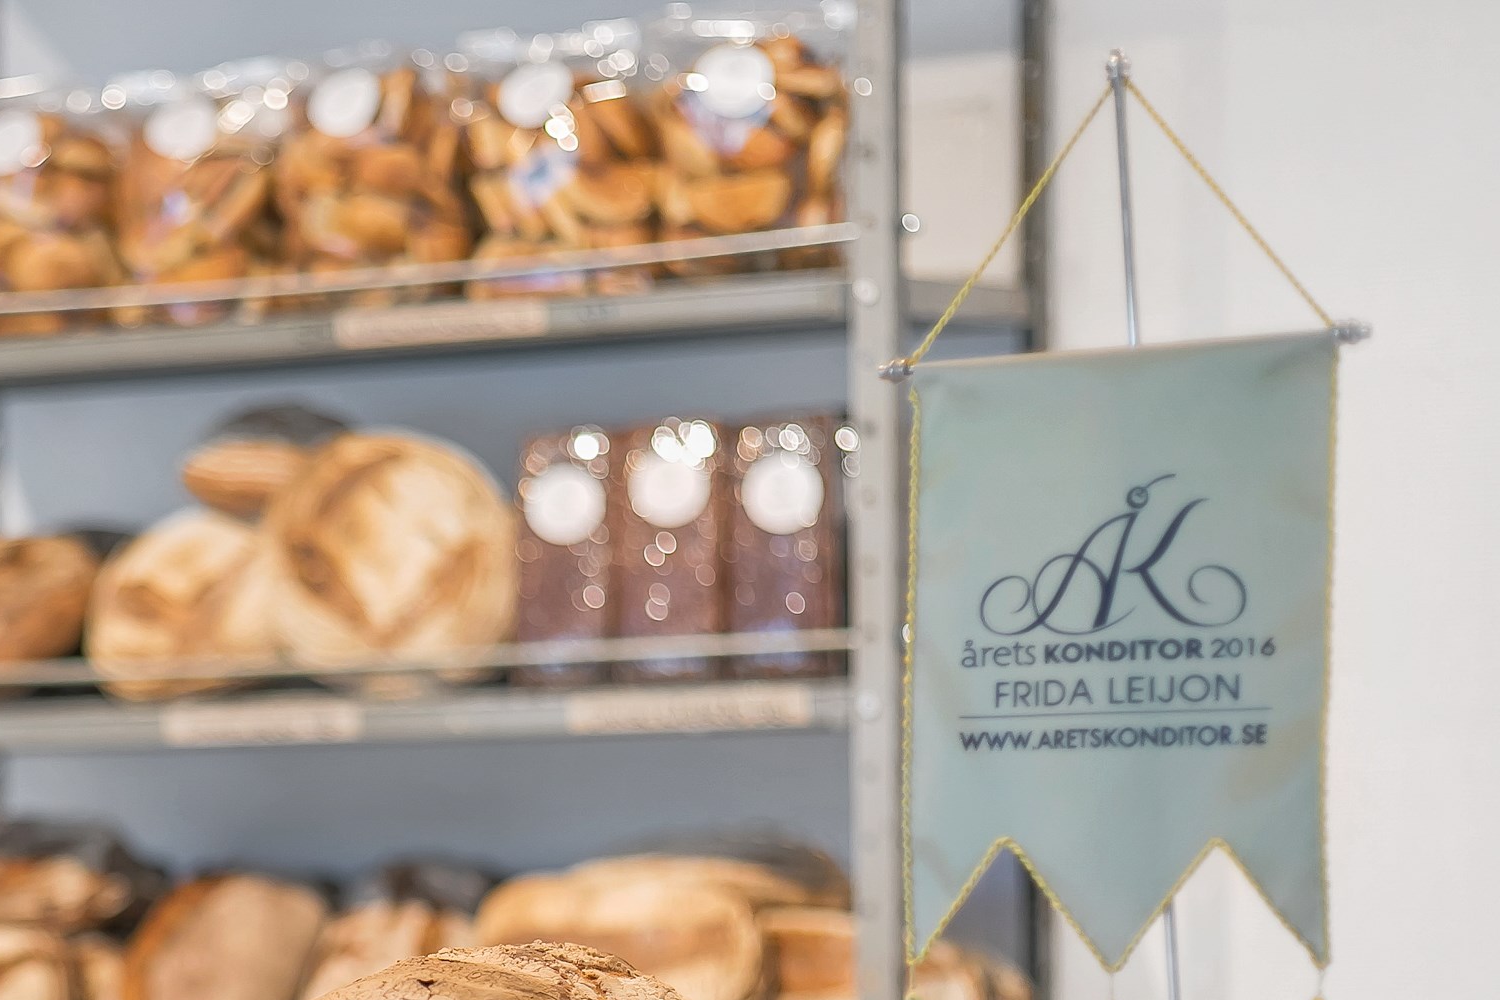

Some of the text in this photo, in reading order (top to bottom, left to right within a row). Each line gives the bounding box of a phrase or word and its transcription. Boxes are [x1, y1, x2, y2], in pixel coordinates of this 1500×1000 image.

[961, 636, 1277, 668] årets KONDITOR 2016
[994, 673, 1242, 709] FRIDA LEIJON
[959, 723, 1268, 752] WWW.ARETSKONDITOR.SE
